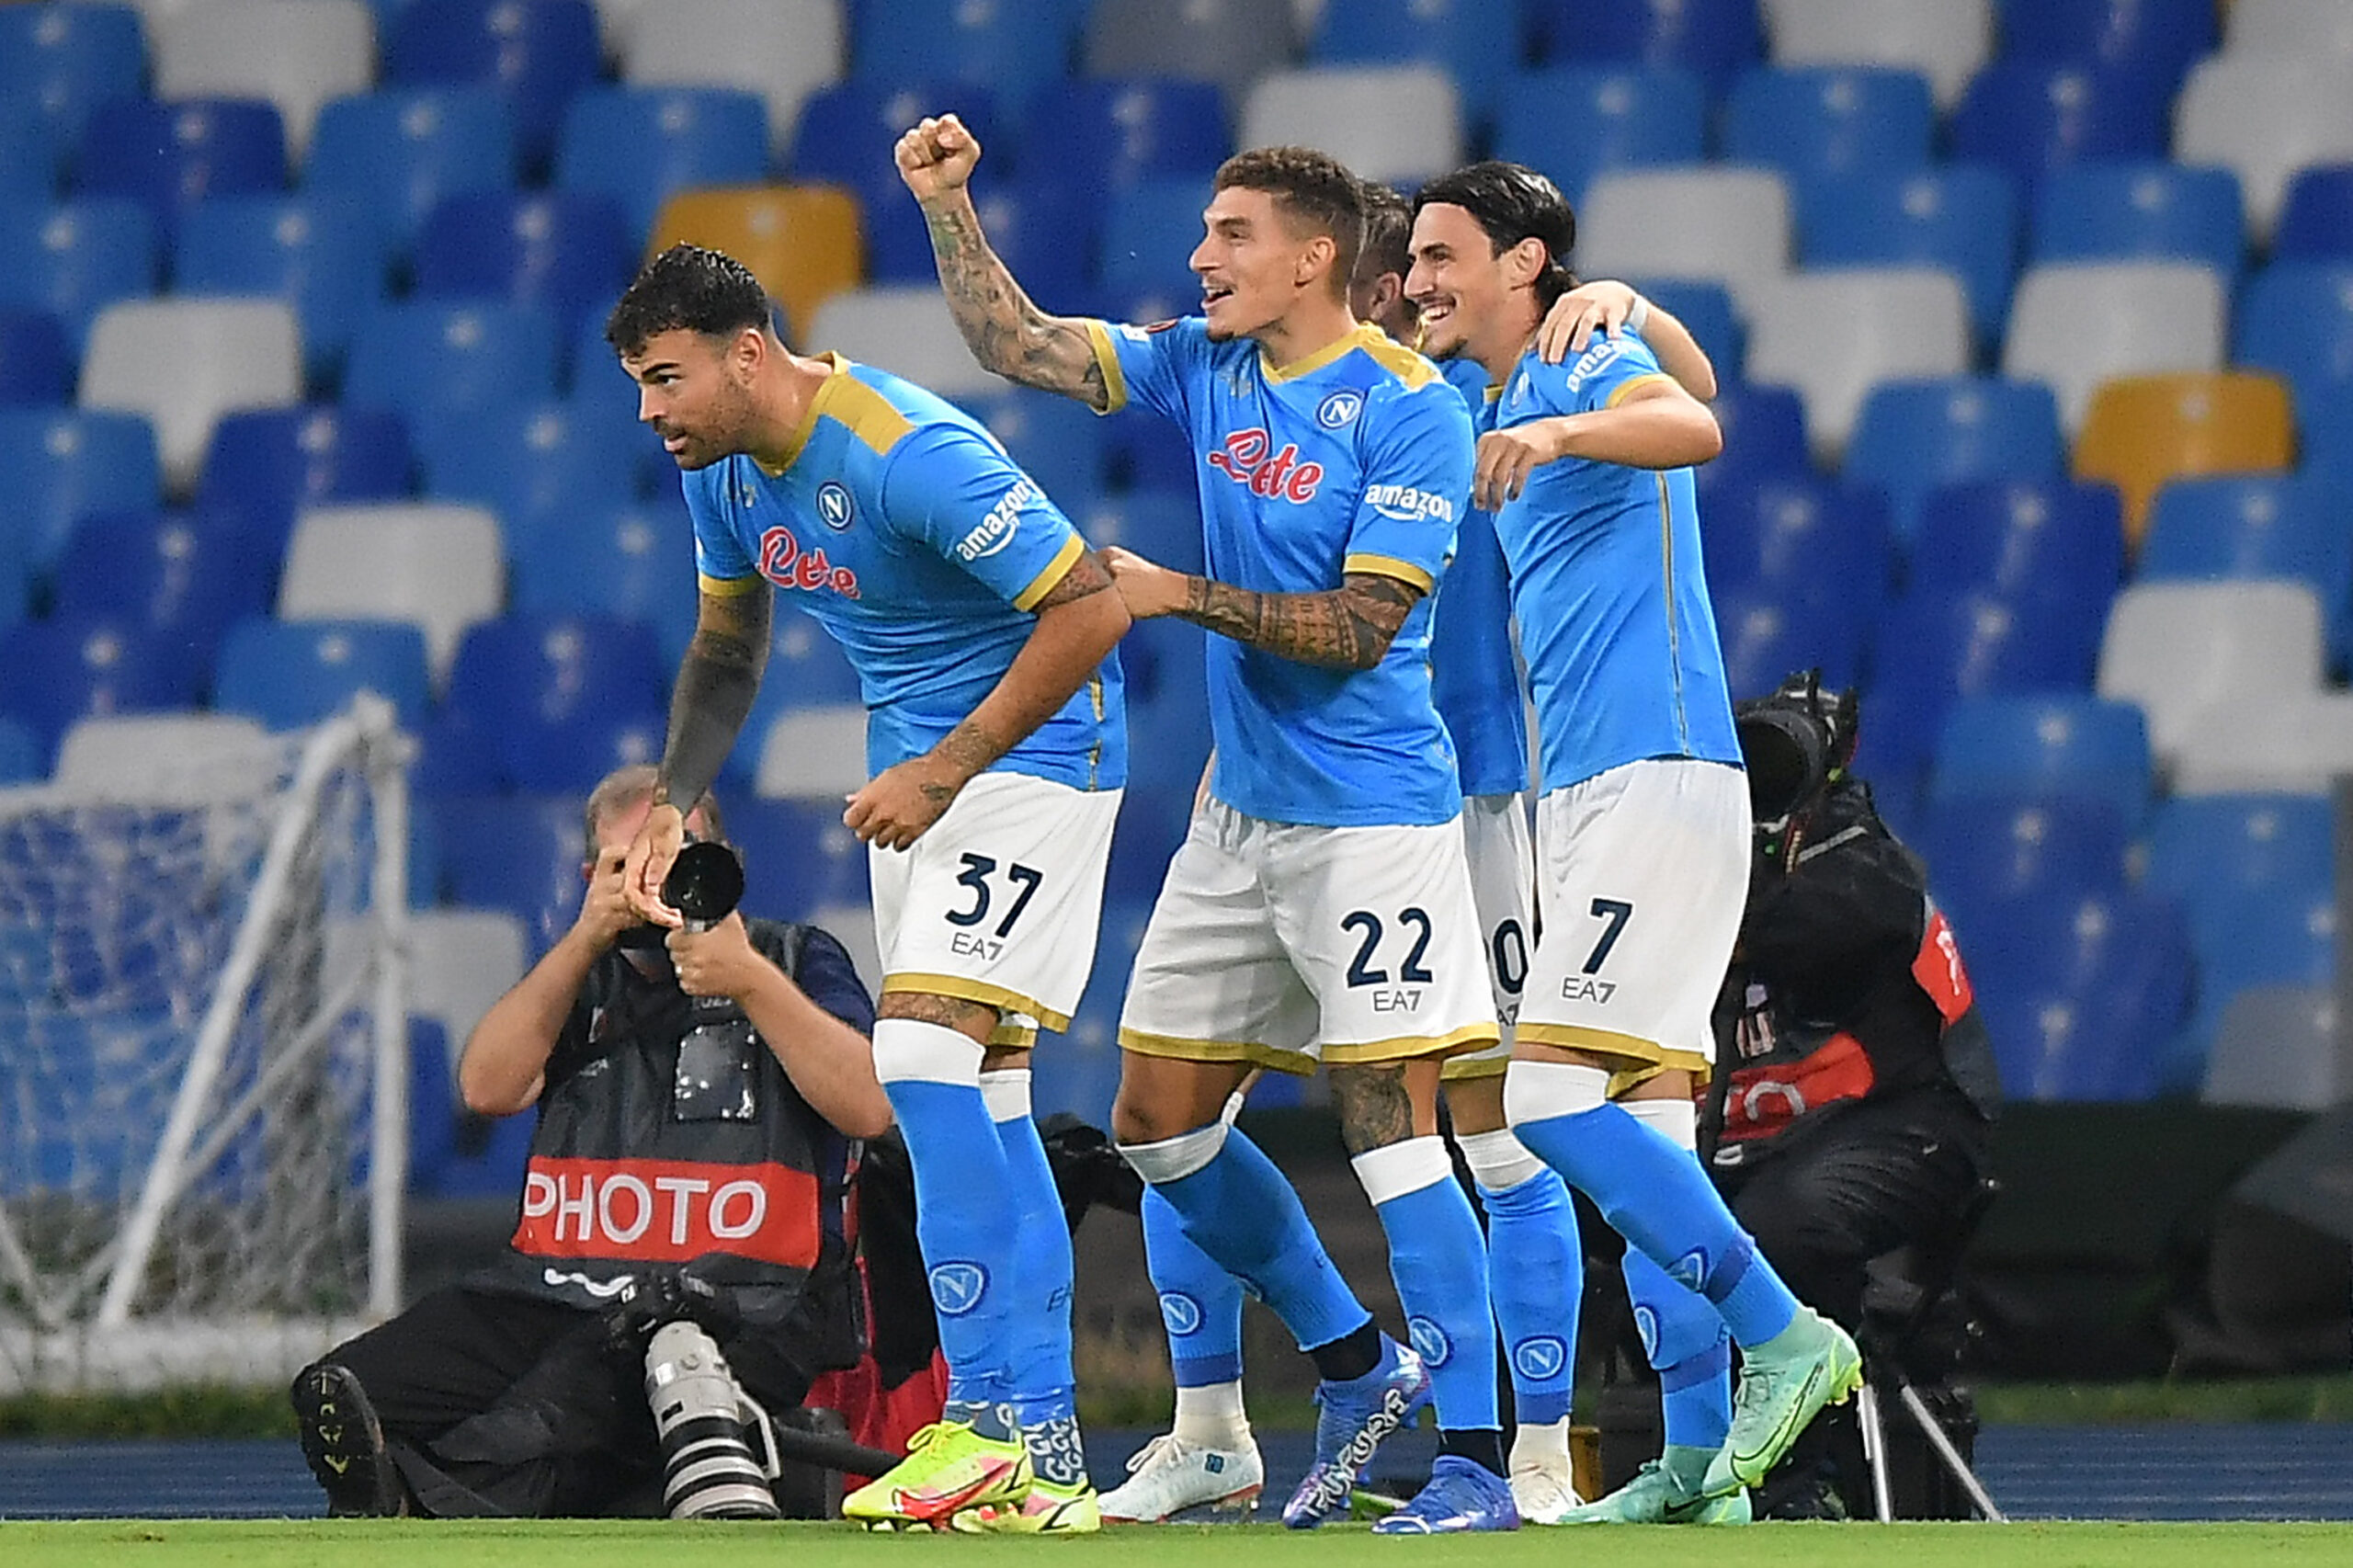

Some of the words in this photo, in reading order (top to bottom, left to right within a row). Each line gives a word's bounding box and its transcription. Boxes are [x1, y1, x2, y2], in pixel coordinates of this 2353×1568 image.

[1326, 400, 1355, 422] N
[1207, 427, 1324, 504] Lete
[824, 494, 844, 520] N
[957, 479, 1030, 562] amazon
[1365, 483, 1454, 523] amazon
[755, 526, 860, 600] Lete
[944, 852, 1042, 938] 37
[951, 932, 1004, 961] EA7
[1340, 906, 1433, 989] 22
[1582, 898, 1632, 975] 7
[1373, 990, 1422, 1012] EA7
[1562, 977, 1617, 1005] EA7
[523, 1172, 767, 1245] PHOTO
